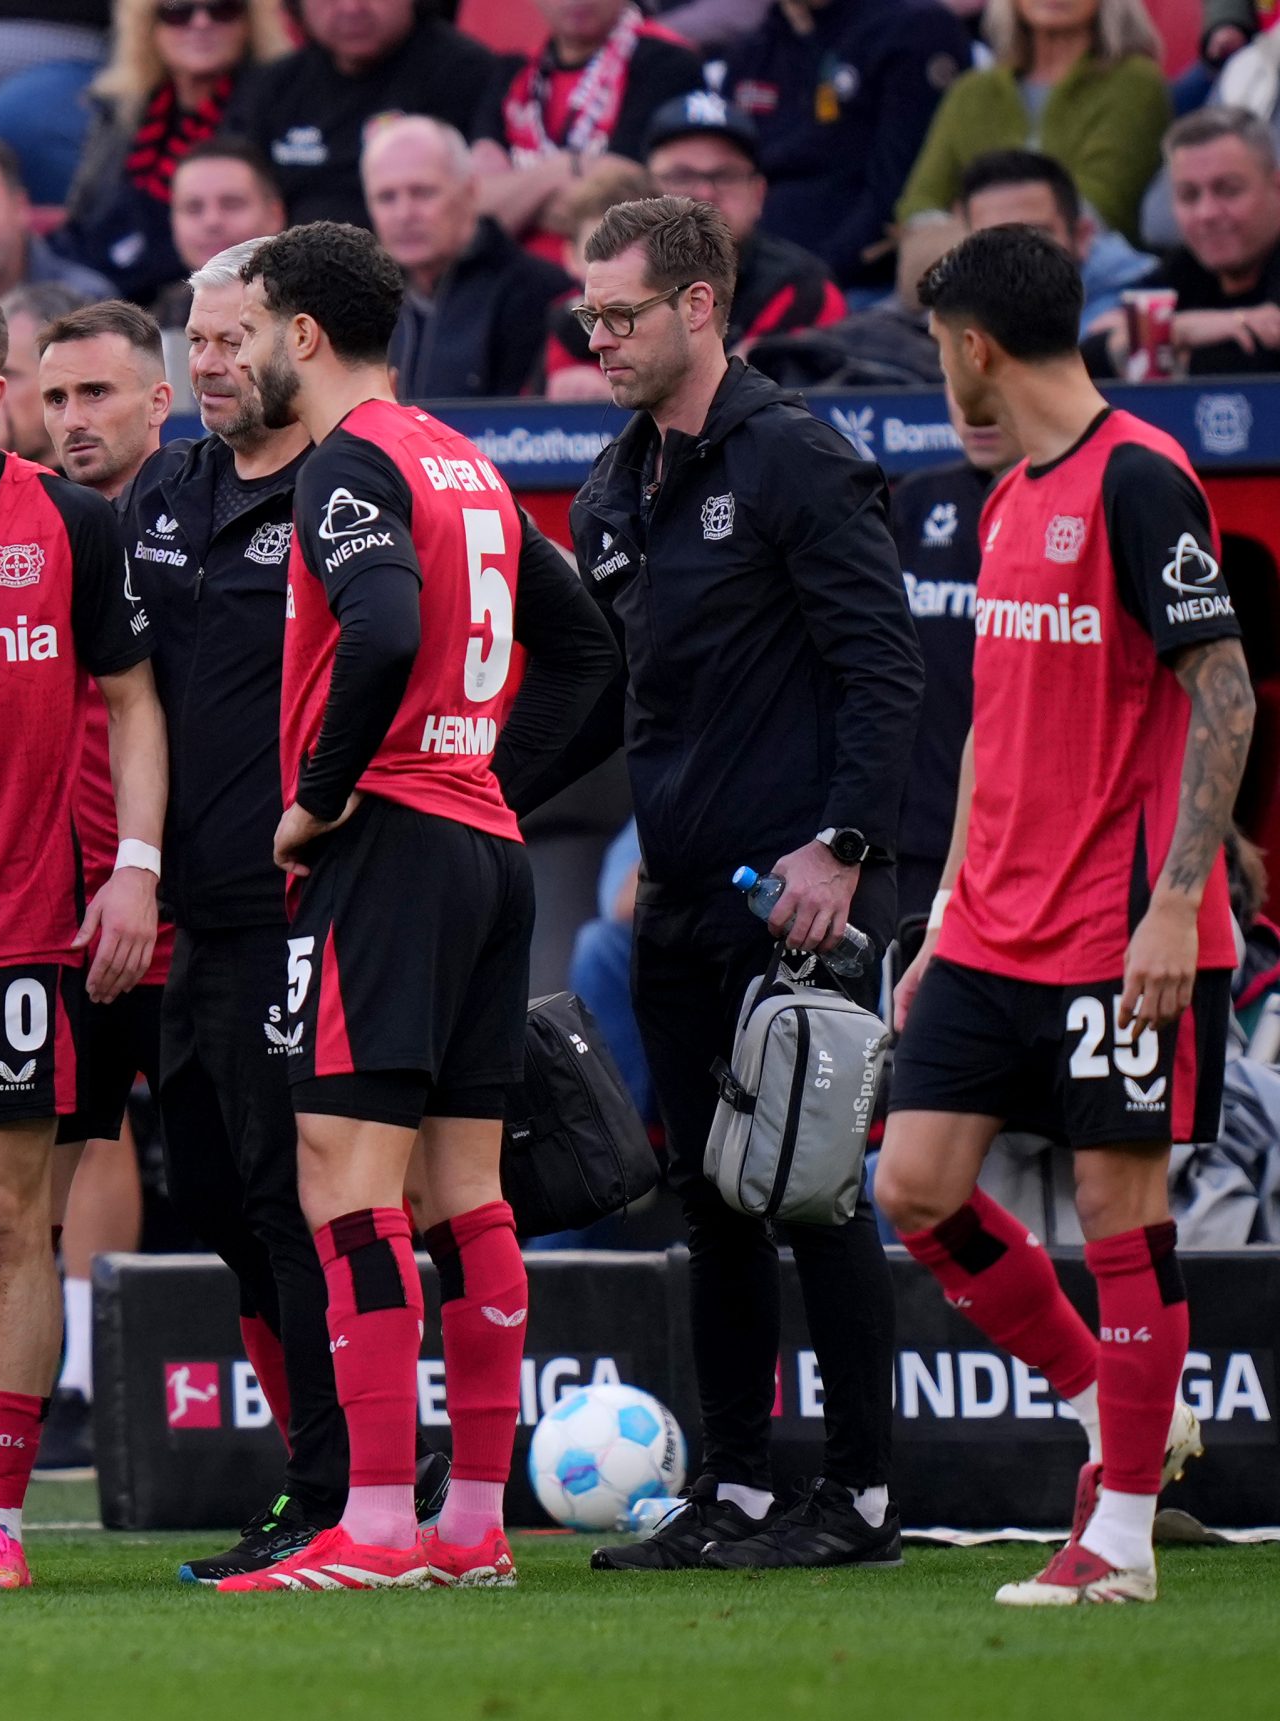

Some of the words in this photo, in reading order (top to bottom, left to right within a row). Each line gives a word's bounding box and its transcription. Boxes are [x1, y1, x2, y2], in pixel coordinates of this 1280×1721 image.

[325, 532, 395, 574] NIEDAX
[462, 507, 515, 703] 5
[1166, 594, 1236, 625] NIEDAX
[286, 935, 315, 1014] 5
[1065, 993, 1160, 1079] 25
[0, 1083, 36, 1092] CASTORE
[814, 1049, 835, 1091] STP
[797, 1350, 1273, 1421] BNDEGA
